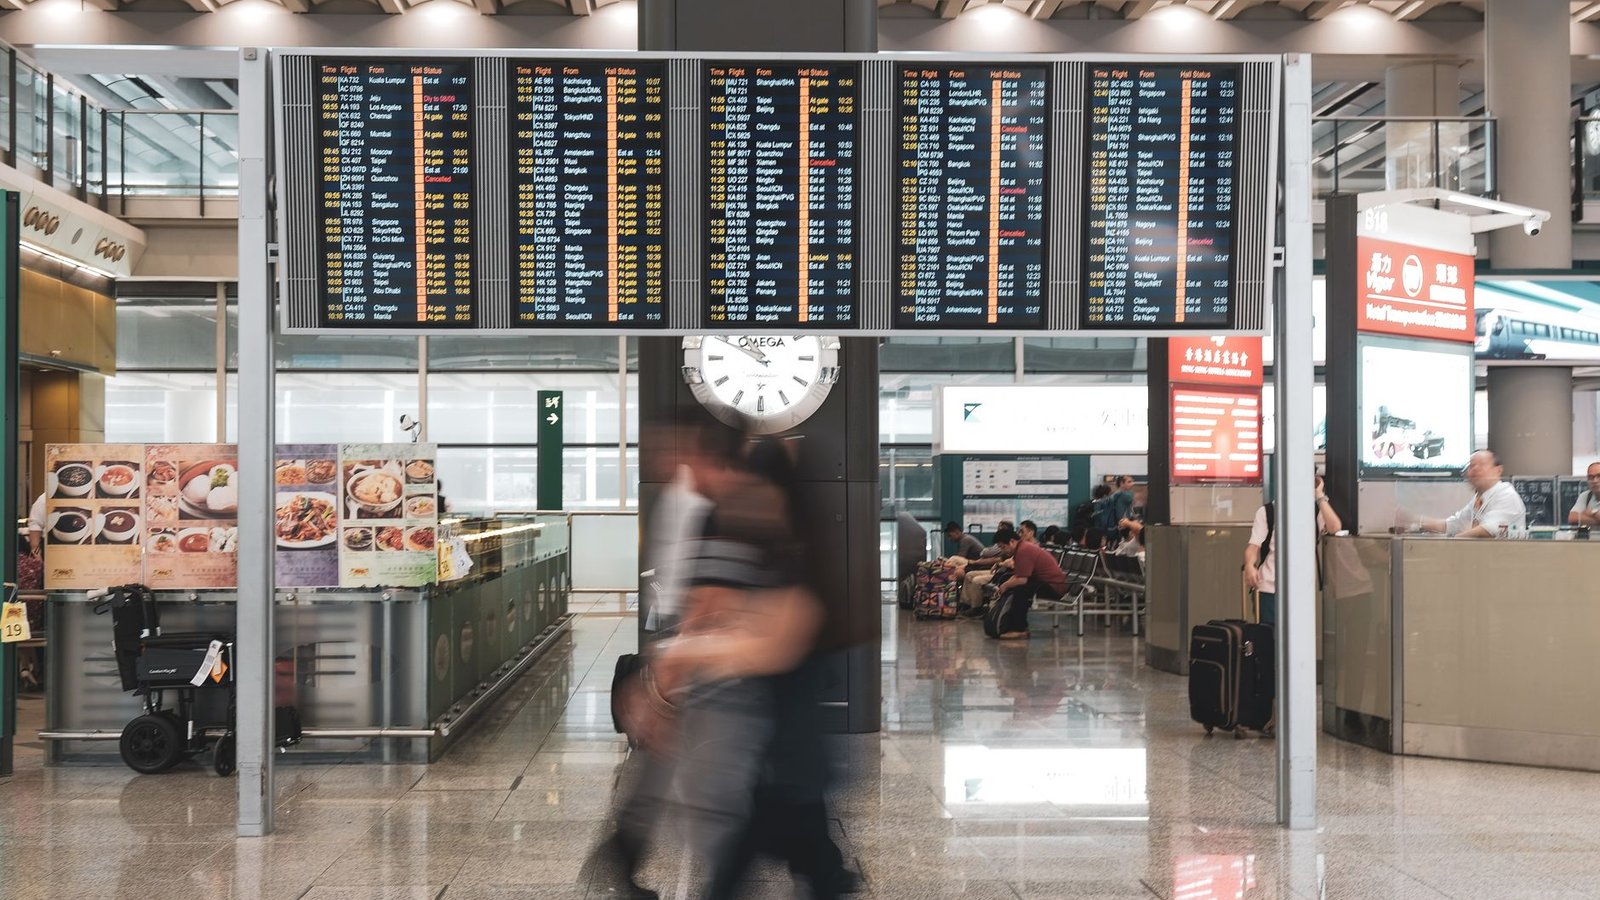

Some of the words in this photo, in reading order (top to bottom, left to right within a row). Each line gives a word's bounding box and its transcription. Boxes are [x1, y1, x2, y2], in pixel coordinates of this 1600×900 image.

[340, 66, 357, 74] Flight
[535, 67, 551, 75] Flight
[728, 68, 745, 77] Flight
[1111, 70, 1128, 79] Flight
[1180, 71, 1191, 79] Hall
[1192, 71, 1211, 79] Status
[921, 71, 938, 79] Flight
[738, 337, 785, 347] OMEGA
[6, 624, 22, 637] 19
